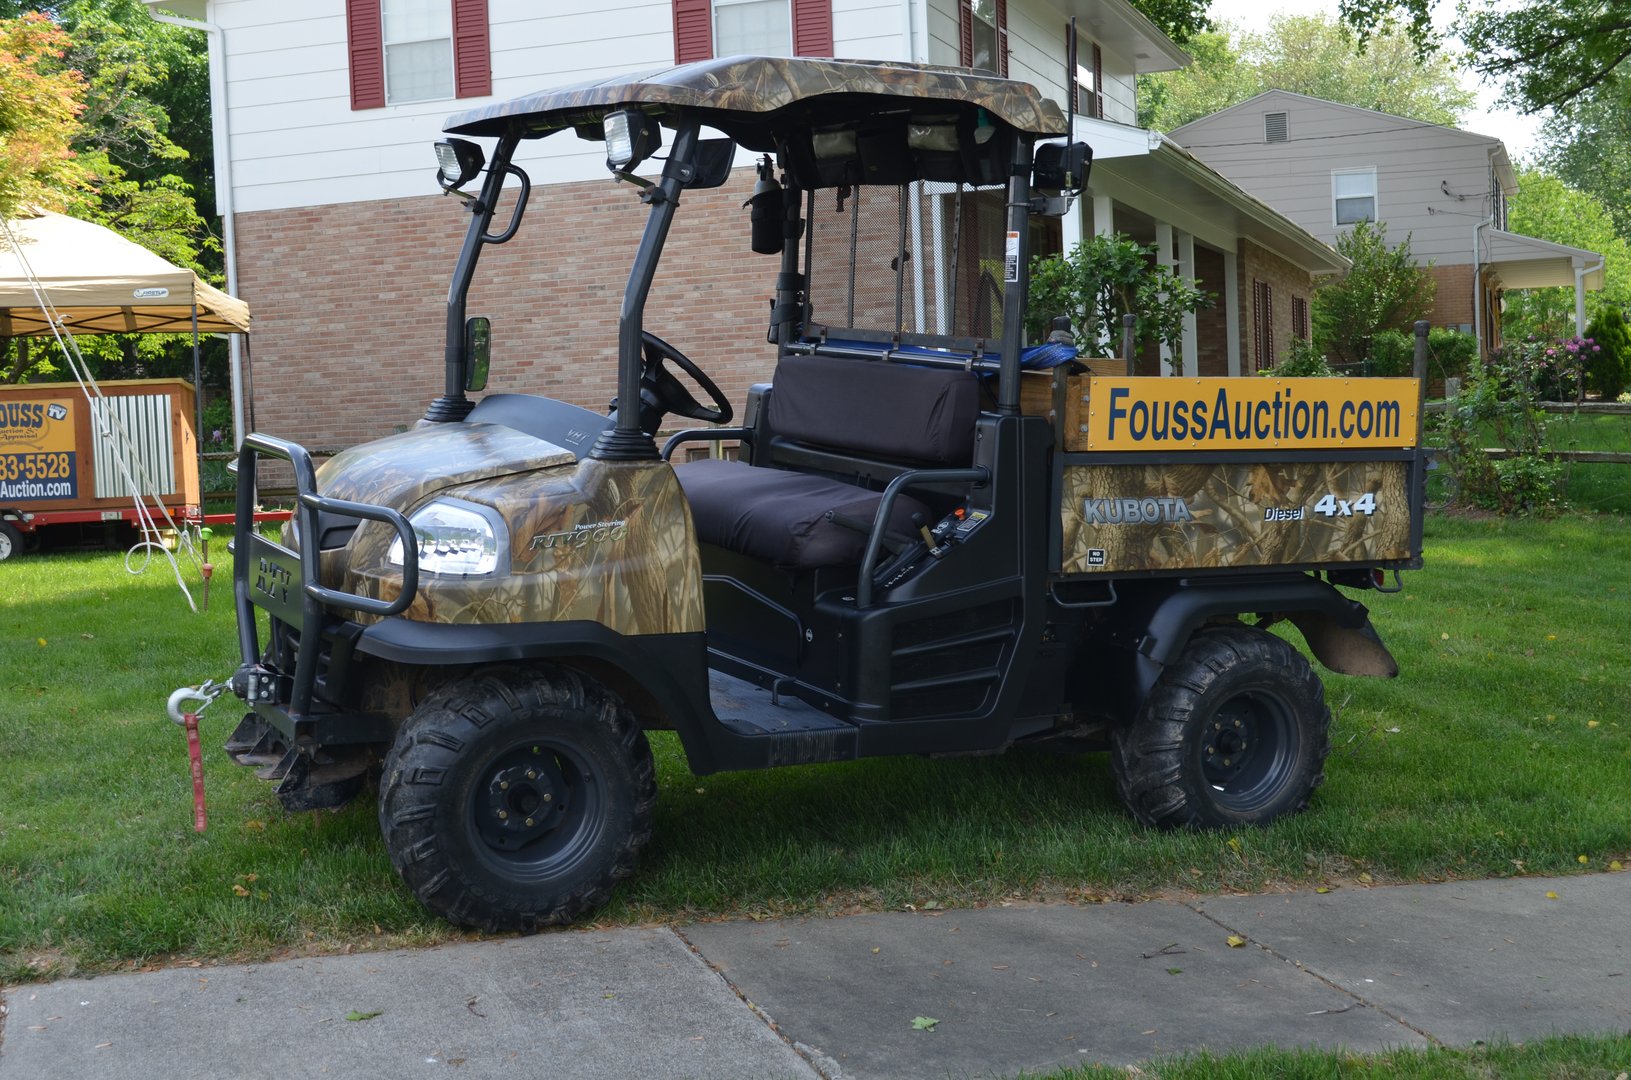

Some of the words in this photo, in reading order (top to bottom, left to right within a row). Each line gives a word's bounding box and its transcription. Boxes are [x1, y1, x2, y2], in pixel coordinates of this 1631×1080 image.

[1107, 387, 1400, 441] FoussAuction.com
[1084, 496, 1193, 525] KUBOTA
[1264, 506, 1305, 521] Diesel
[1314, 492, 1377, 517] 4x4
[529, 525, 628, 551] RTV900
[575, 522, 598, 531] Power
[598, 520, 626, 529] Steering
